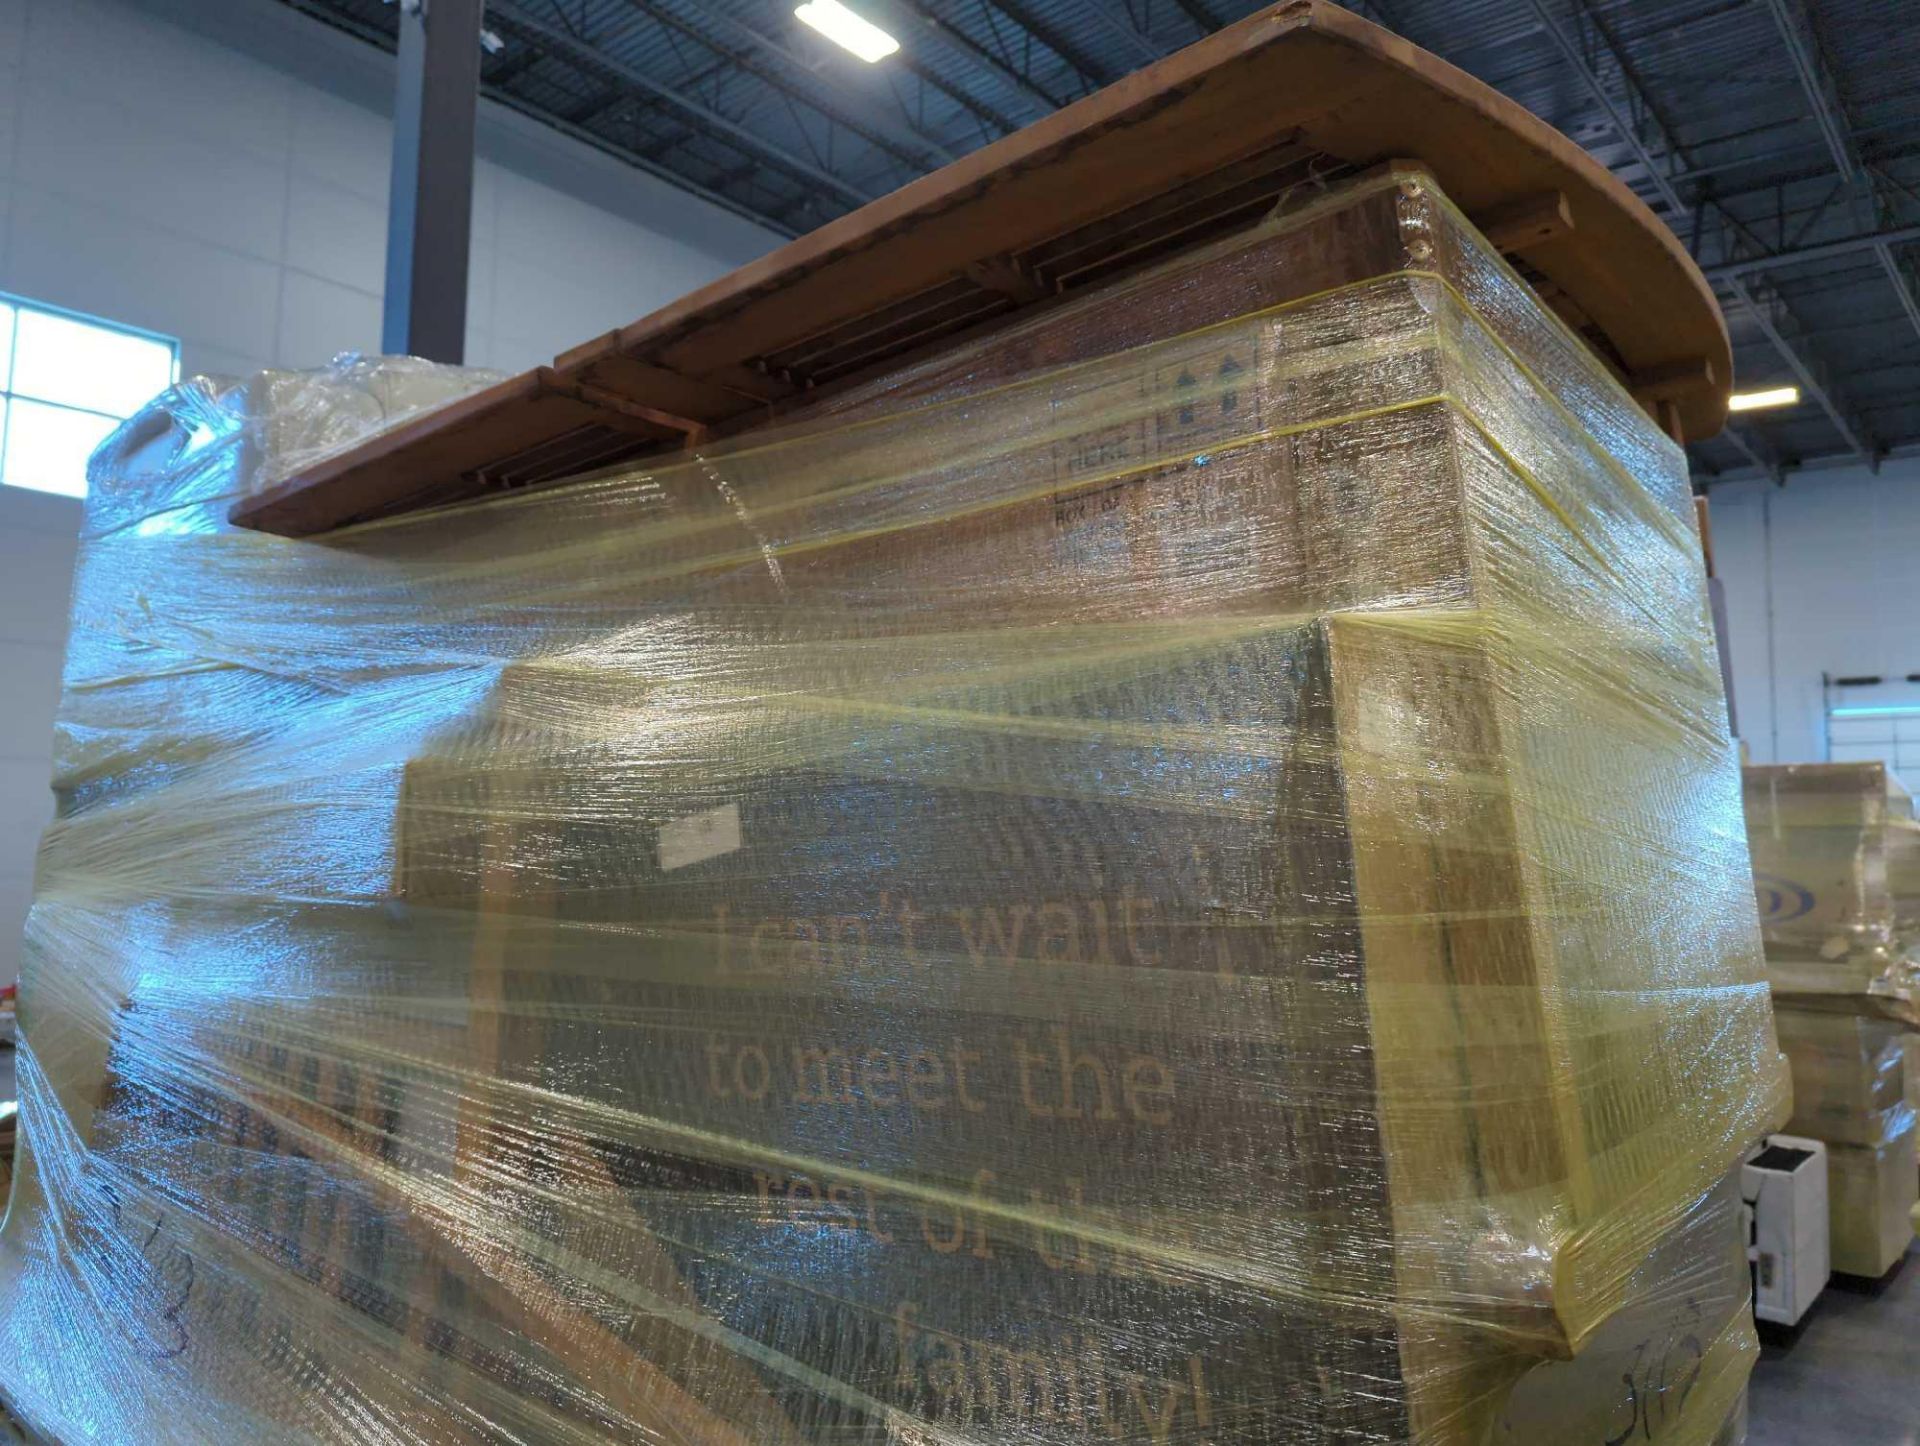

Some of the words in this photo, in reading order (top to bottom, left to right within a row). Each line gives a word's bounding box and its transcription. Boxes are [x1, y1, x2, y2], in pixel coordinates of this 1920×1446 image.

[750, 889, 933, 975] can't
[955, 884, 1163, 968] wait
[705, 1032, 771, 1100] to
[791, 1035, 985, 1112] meet
[1016, 1027, 1177, 1125] the
[753, 1171, 895, 1243] rest
[920, 1168, 995, 1259] of
